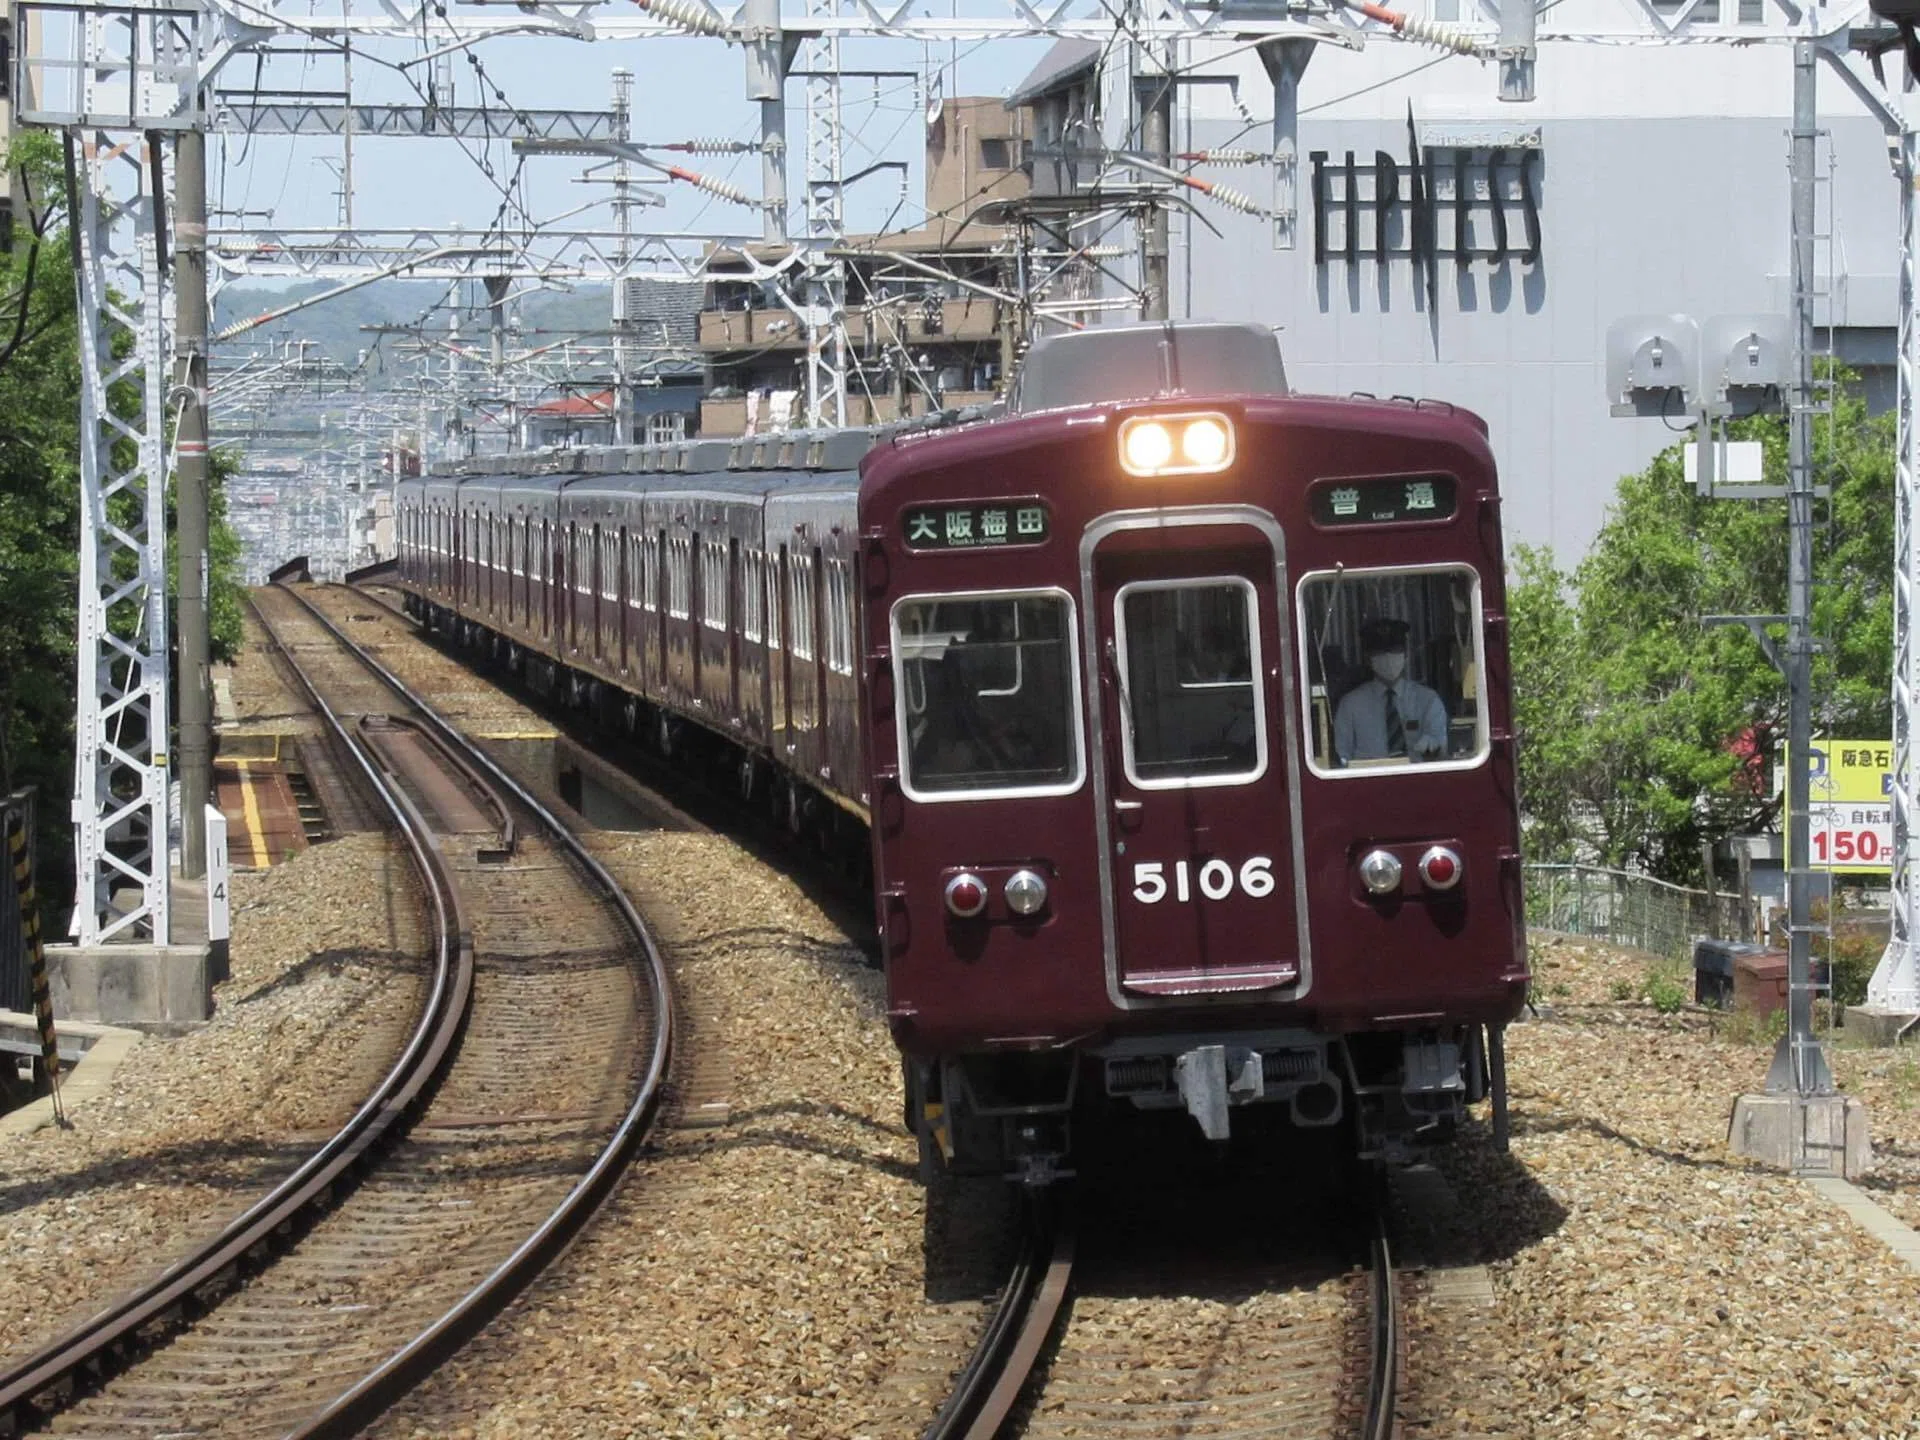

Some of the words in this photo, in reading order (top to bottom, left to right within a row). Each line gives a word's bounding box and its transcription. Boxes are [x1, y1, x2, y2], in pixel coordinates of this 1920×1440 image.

[910, 508, 1043, 541] 大阪梅田
[1841, 749, 1895, 768] 阪急石
[1132, 856, 1275, 904] 5106
